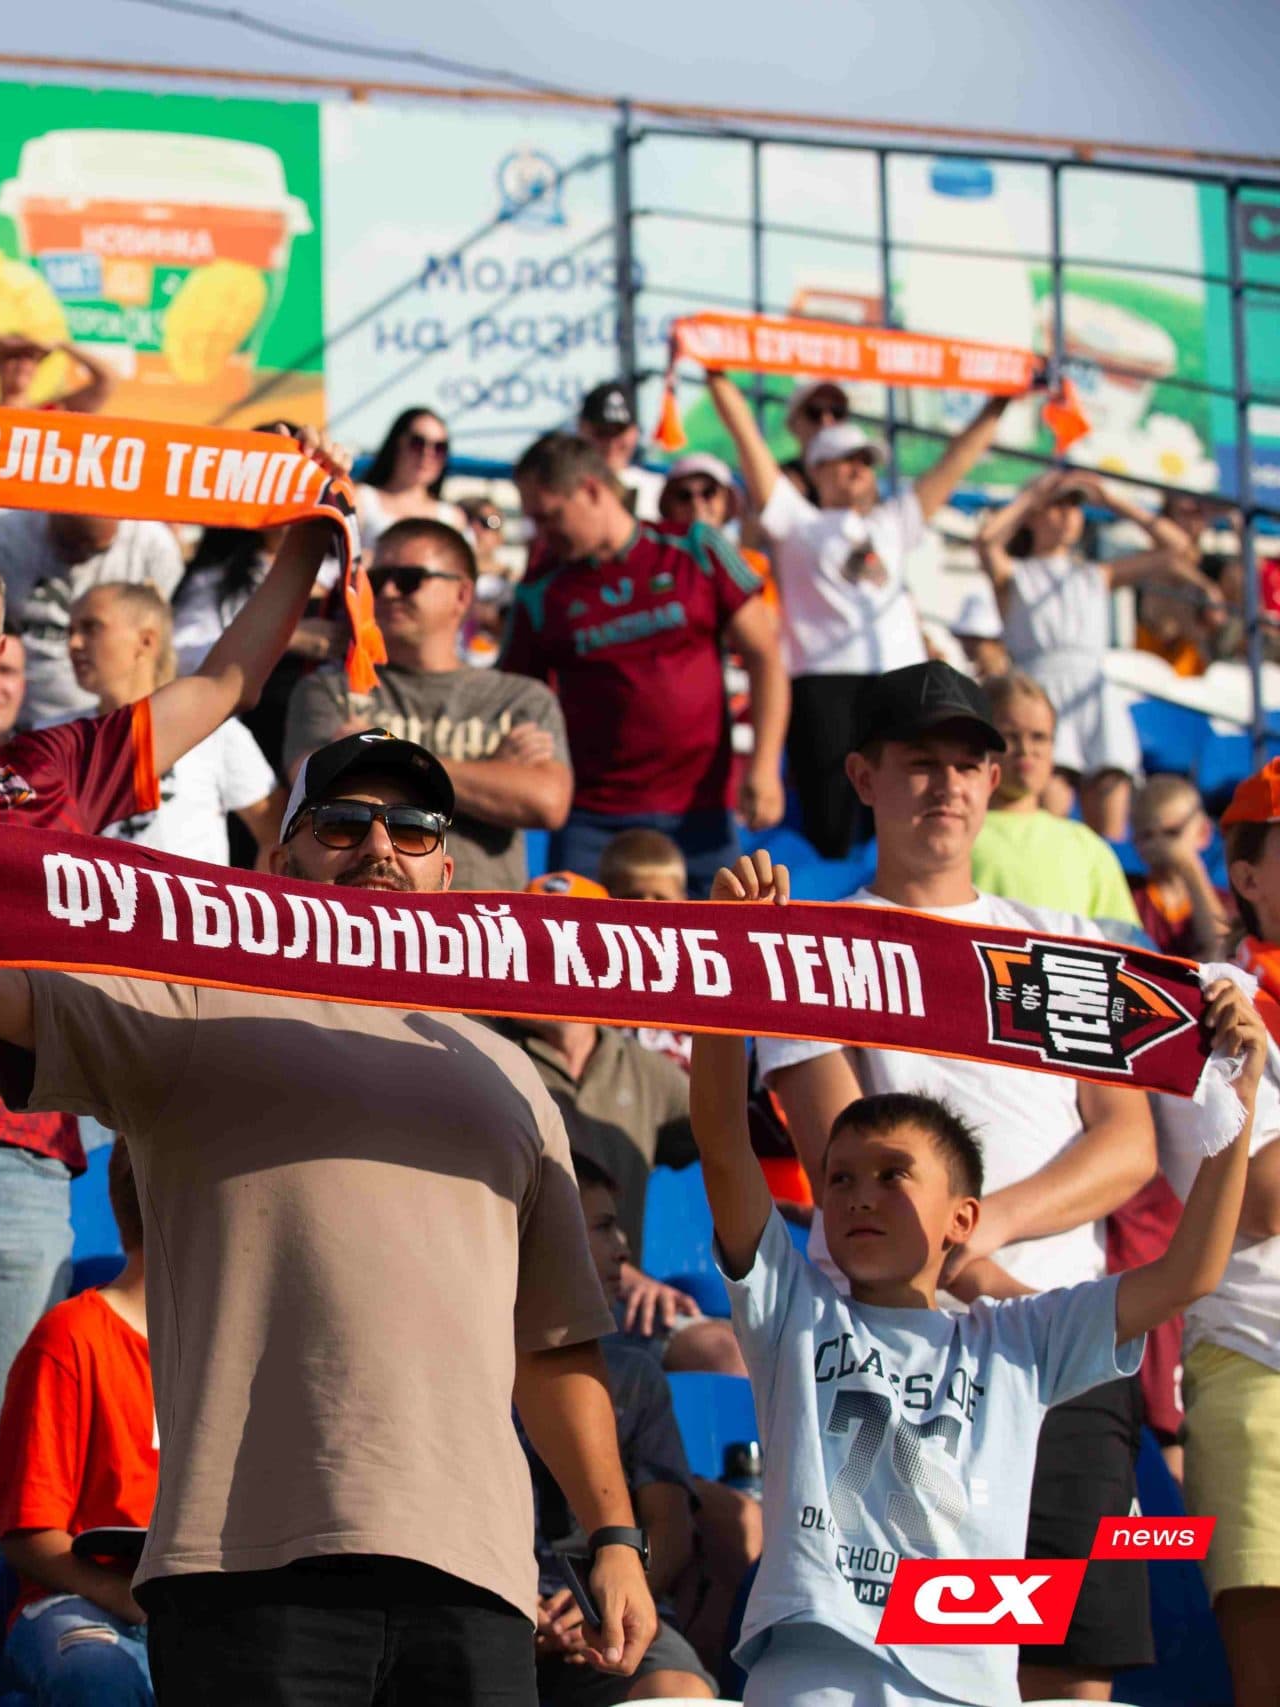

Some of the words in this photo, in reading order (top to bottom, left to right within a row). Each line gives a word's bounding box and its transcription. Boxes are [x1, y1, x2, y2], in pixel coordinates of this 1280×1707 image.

[165, 442, 317, 505] ТЕМП!
[43, 852, 530, 983] ФУТБОЛЬНЫЙ
[541, 918, 732, 998] КЛУБ
[747, 931, 926, 1017] ТЕМП
[1021, 983, 1042, 1011] ФК
[1042, 953, 1113, 1055] ТЕМП
[1112, 997, 1125, 1023] 2020
